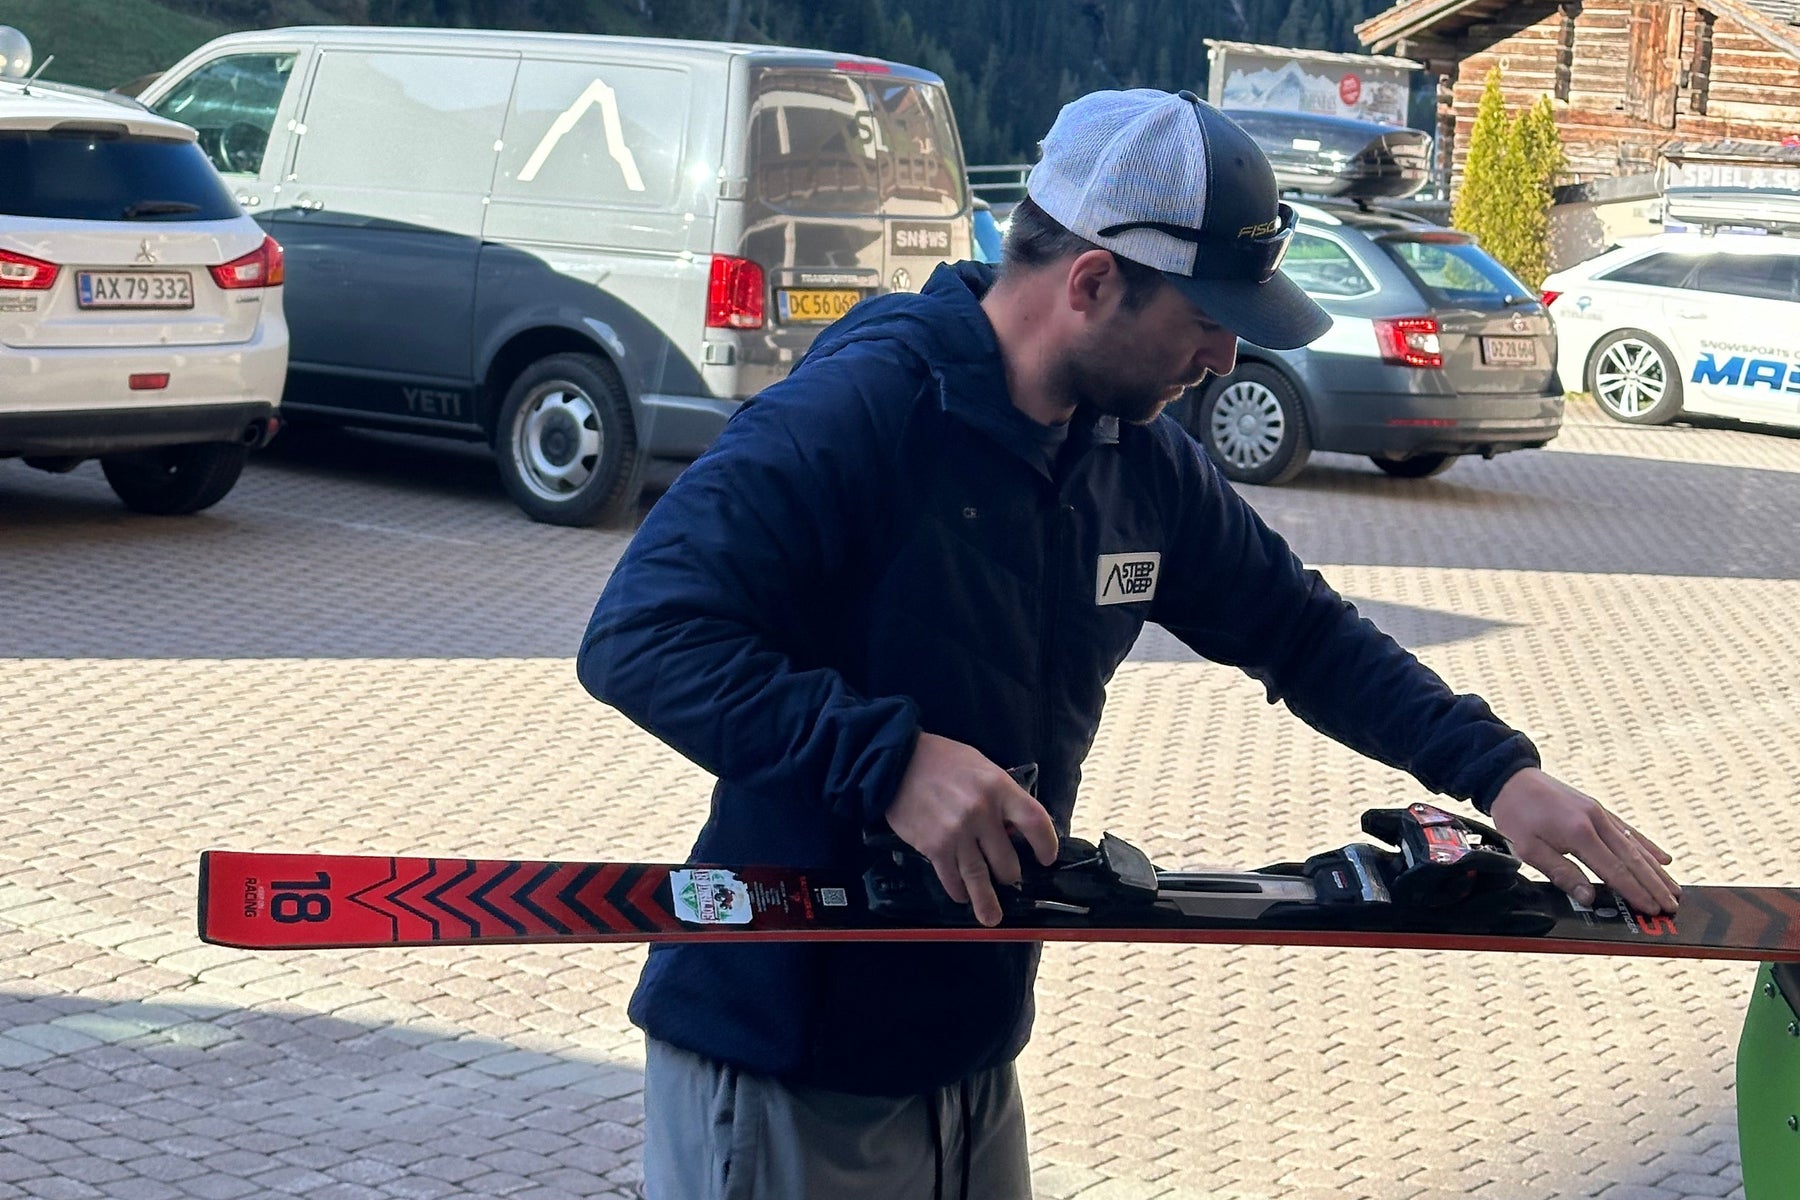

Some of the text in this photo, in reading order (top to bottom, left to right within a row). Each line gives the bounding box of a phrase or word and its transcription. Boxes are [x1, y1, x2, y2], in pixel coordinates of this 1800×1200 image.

[1684, 164, 1746, 188] SPIEL
[95, 278, 189, 299] AX 79 332
[789, 295, 809, 314] DC
[813, 295, 830, 314] 56
[1700, 339, 1790, 358] SNOWSPORTS
[402, 386, 461, 416] YETI
[1122, 561, 1155, 579] STEEP
[1126, 577, 1152, 594] DEEP
[244, 877, 257, 918] RACING
[270, 871, 331, 924] 18
[1613, 895, 1639, 934] ACETIGER
